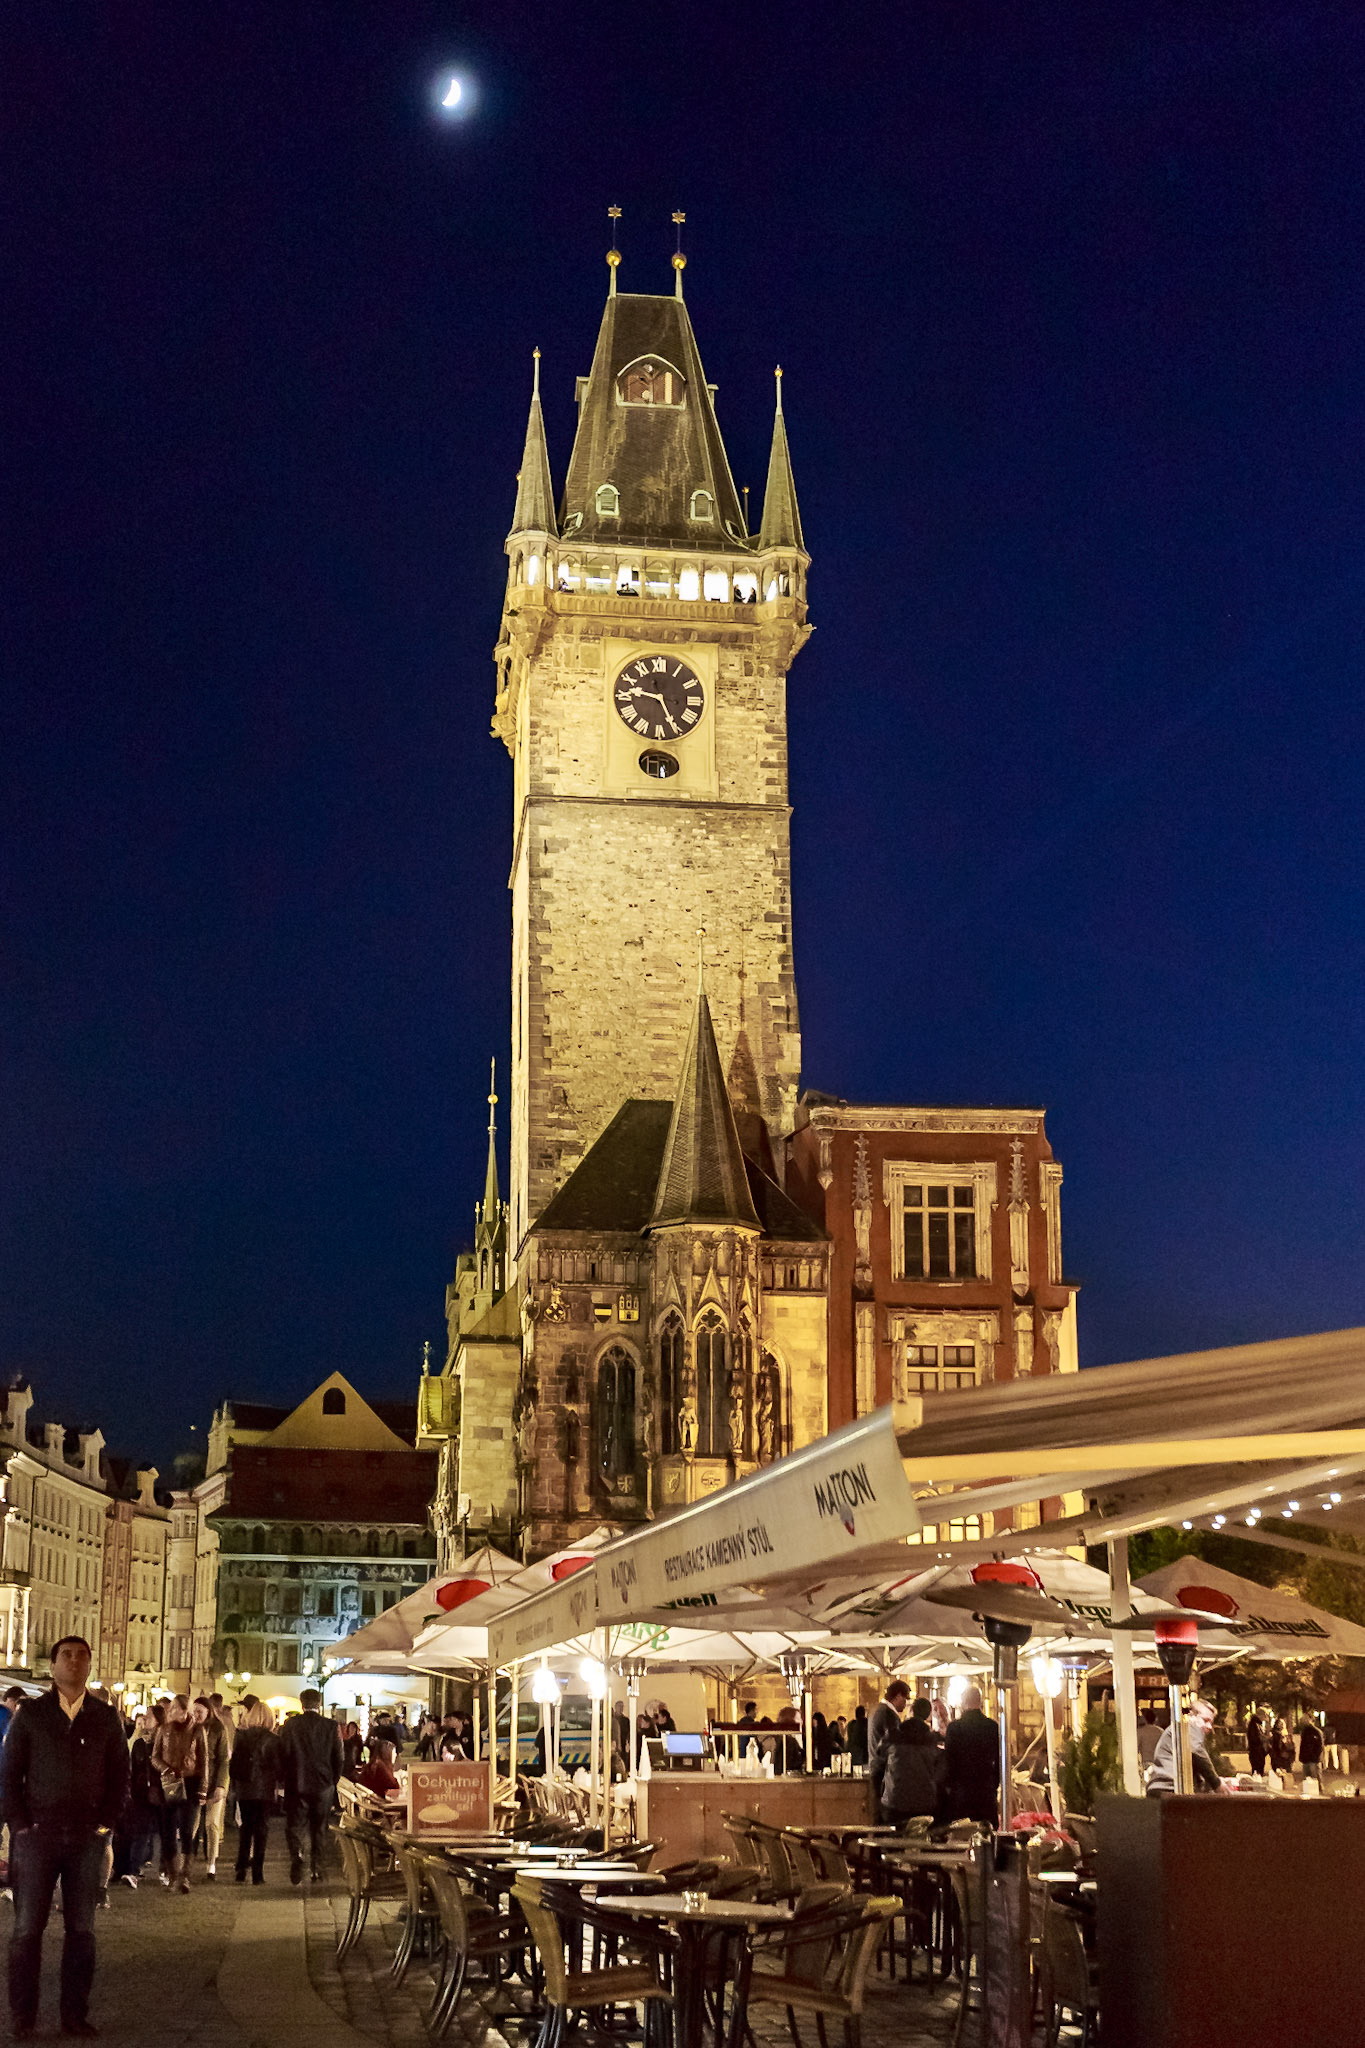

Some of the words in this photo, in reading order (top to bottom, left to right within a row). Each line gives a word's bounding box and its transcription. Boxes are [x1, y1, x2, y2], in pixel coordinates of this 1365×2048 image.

[634, 662, 650, 677] XI
[651, 659, 667, 673] XII
[672, 664, 683, 677] I
[621, 674, 637, 686] X
[682, 679, 698, 690] II
[687, 696, 701, 706] III
[633, 718, 650, 734] VII
[655, 725, 666, 738] VI
[814, 1463, 877, 1519] MATTONI
[664, 1546, 705, 1582] RESTAURACE
[417, 1774, 484, 1790] Ochutnej
